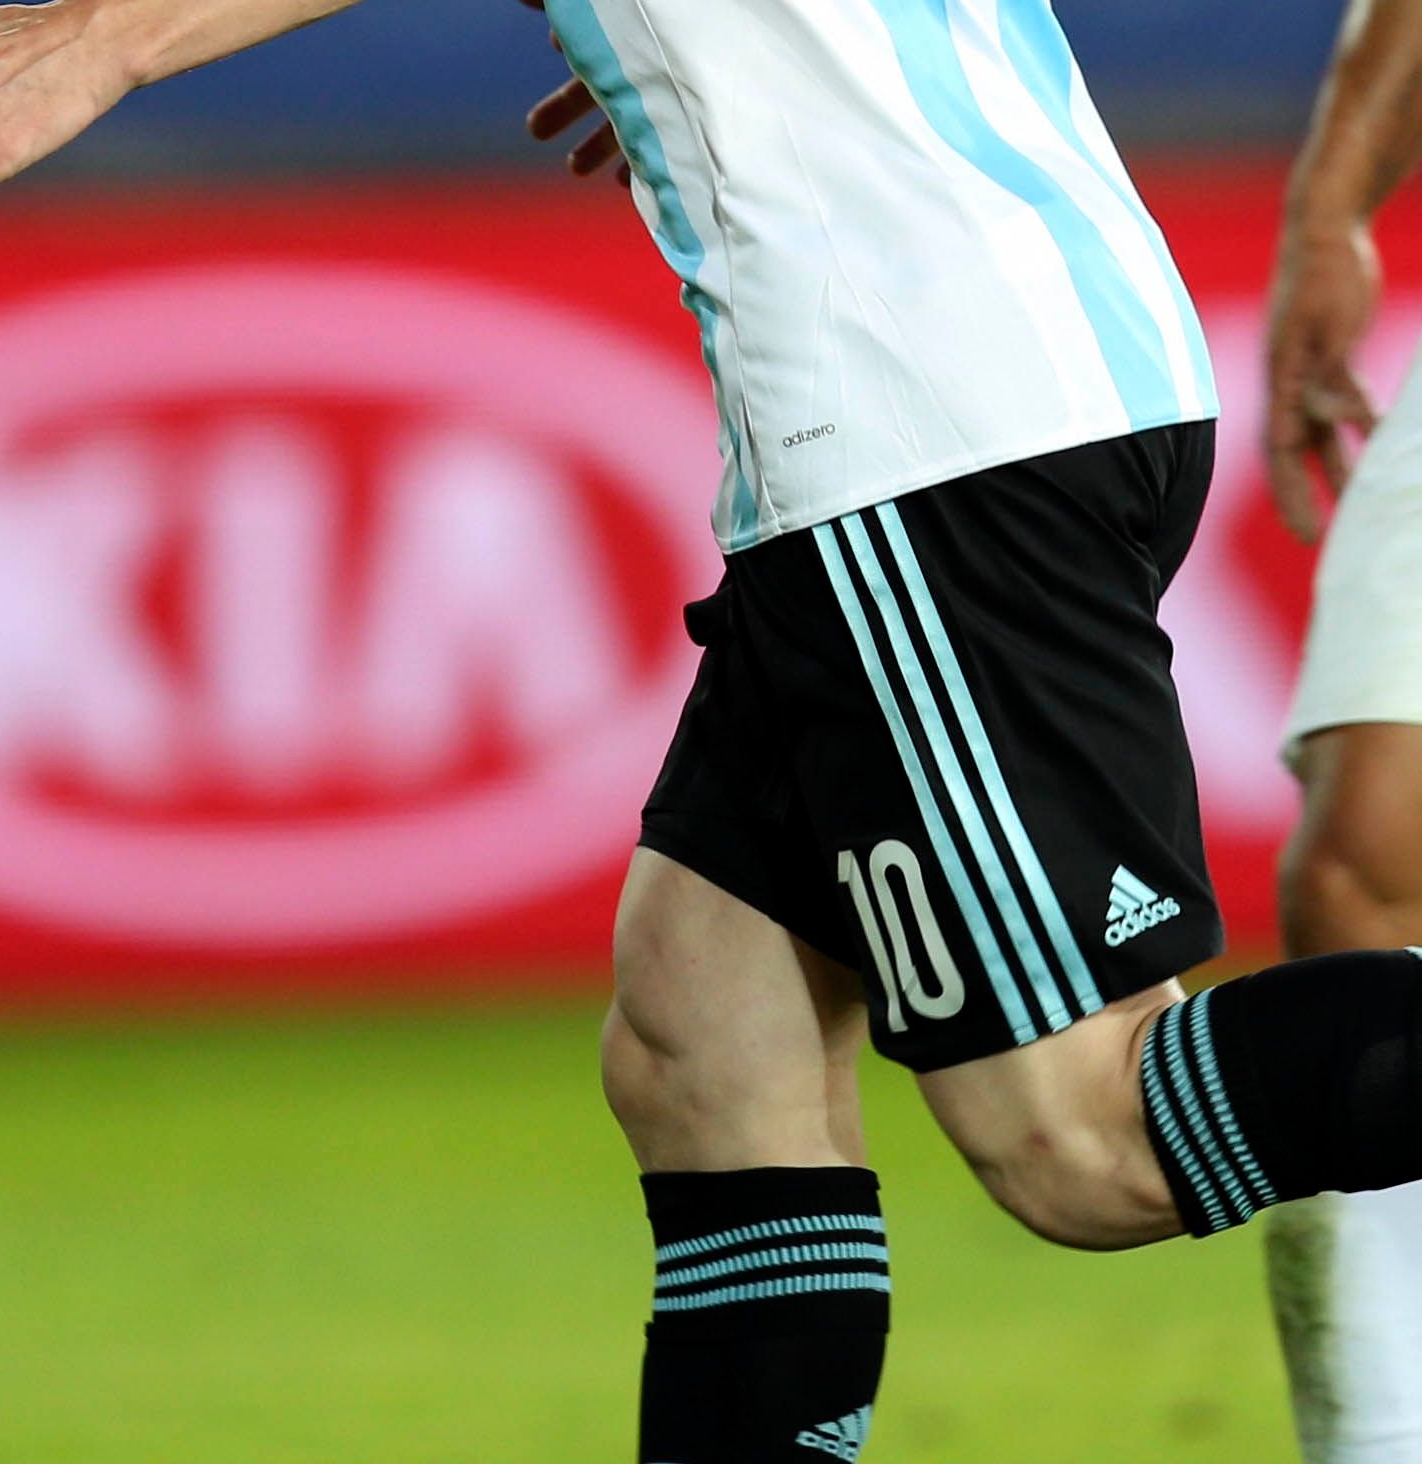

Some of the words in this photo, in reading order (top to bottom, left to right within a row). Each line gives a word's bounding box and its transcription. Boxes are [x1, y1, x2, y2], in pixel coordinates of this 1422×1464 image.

[782, 423, 836, 448] adizero
[836, 838, 966, 1034] 10
[1104, 897, 1180, 947] adidas
